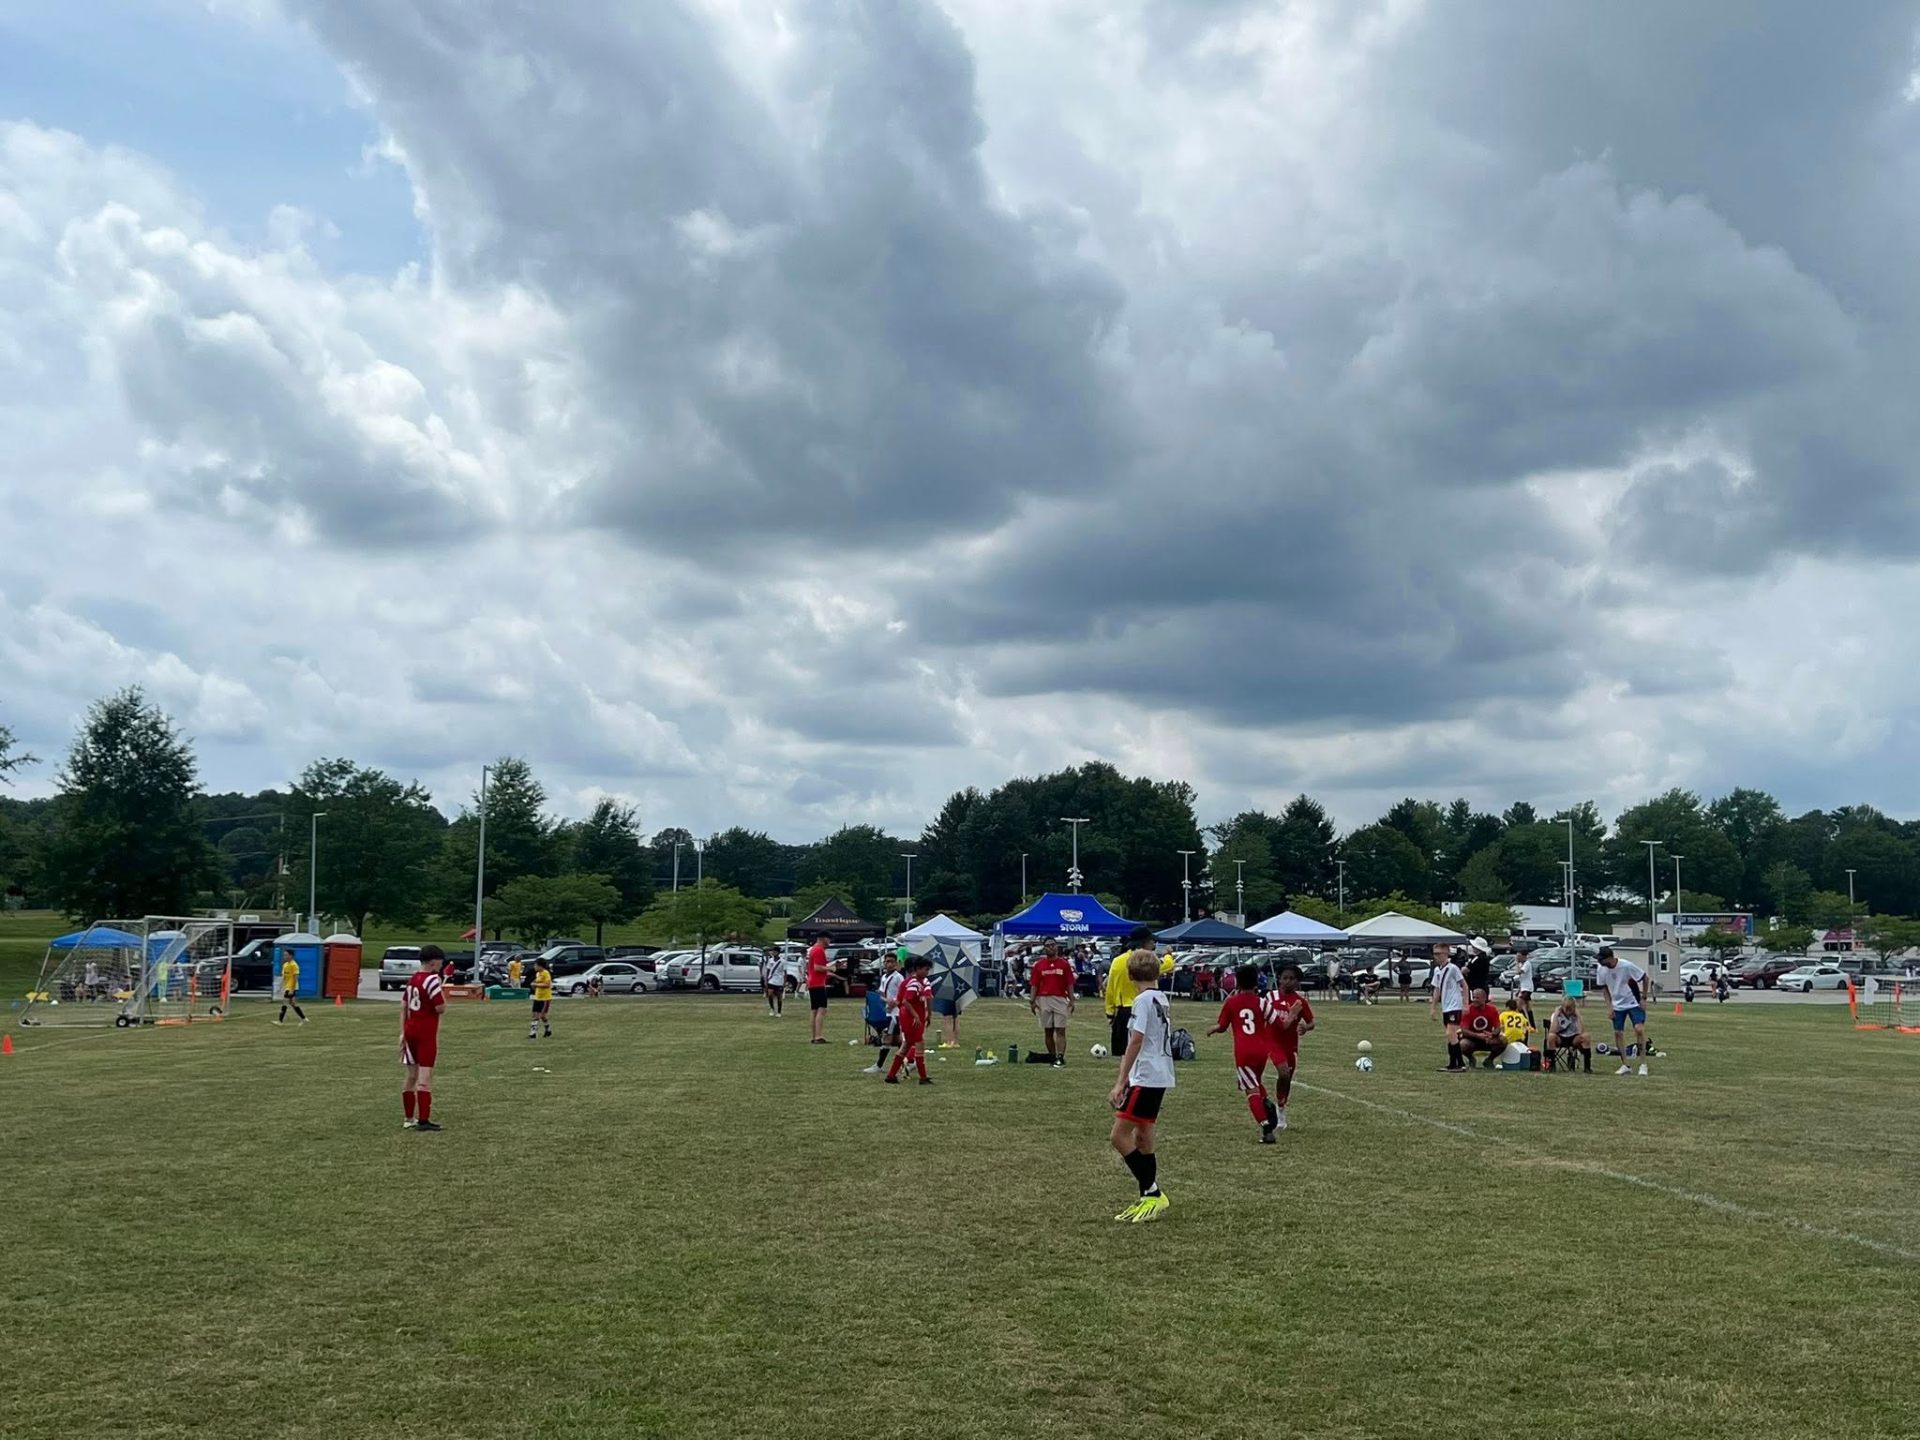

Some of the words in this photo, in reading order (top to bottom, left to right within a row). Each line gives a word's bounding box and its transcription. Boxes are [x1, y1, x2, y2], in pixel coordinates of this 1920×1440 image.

[1060, 923, 1089, 932] STORM
[1239, 1008, 1256, 1035] 3
[1507, 1015, 1522, 1029] 22
